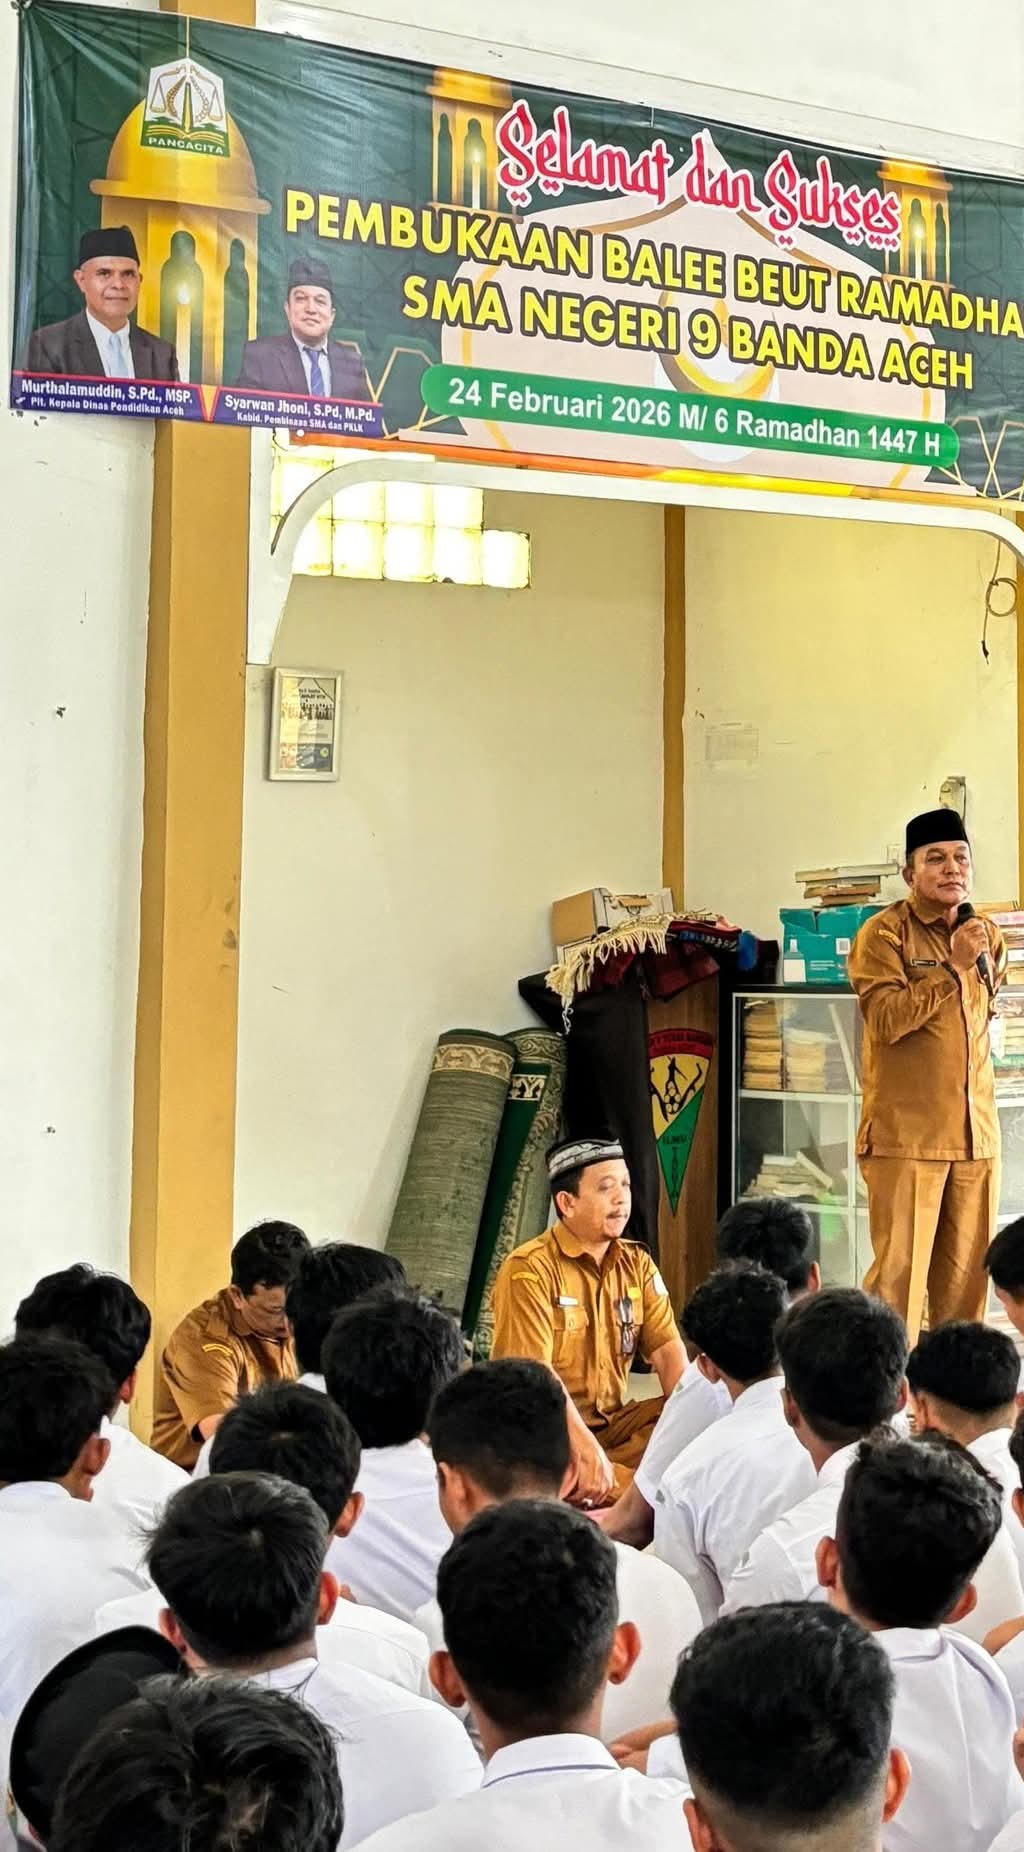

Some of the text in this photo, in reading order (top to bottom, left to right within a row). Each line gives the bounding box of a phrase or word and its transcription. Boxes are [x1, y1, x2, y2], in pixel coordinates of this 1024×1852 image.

[148, 137, 224, 154] PANCACITA
[499, 102, 899, 247] Selamat dan Sukses
[285, 188, 591, 274] PEMBUKAAN
[606, 237, 723, 296] BALEE
[736, 258, 830, 311] BEUT
[402, 274, 973, 390] SMA NEGERI 9 BANDA ACEH
[21, 379, 126, 401] Murthalamuddin,
[128, 385, 162, 404] S.Pd.,
[30, 396, 185, 416] Plt. Kepala Dinas Pendidikan Aceh
[224, 394, 376, 422] Syarwan Jhoni, S.Pd, M.Pd.
[448, 377, 940, 456] 24 Februari 2026 M/ 6 Ramadhan 1447 H
[236, 411, 262, 423] Kabid.
[264, 414, 308, 427] Pembinaan
[308, 418, 327, 429] SMA
[327, 420, 342, 430] dan
